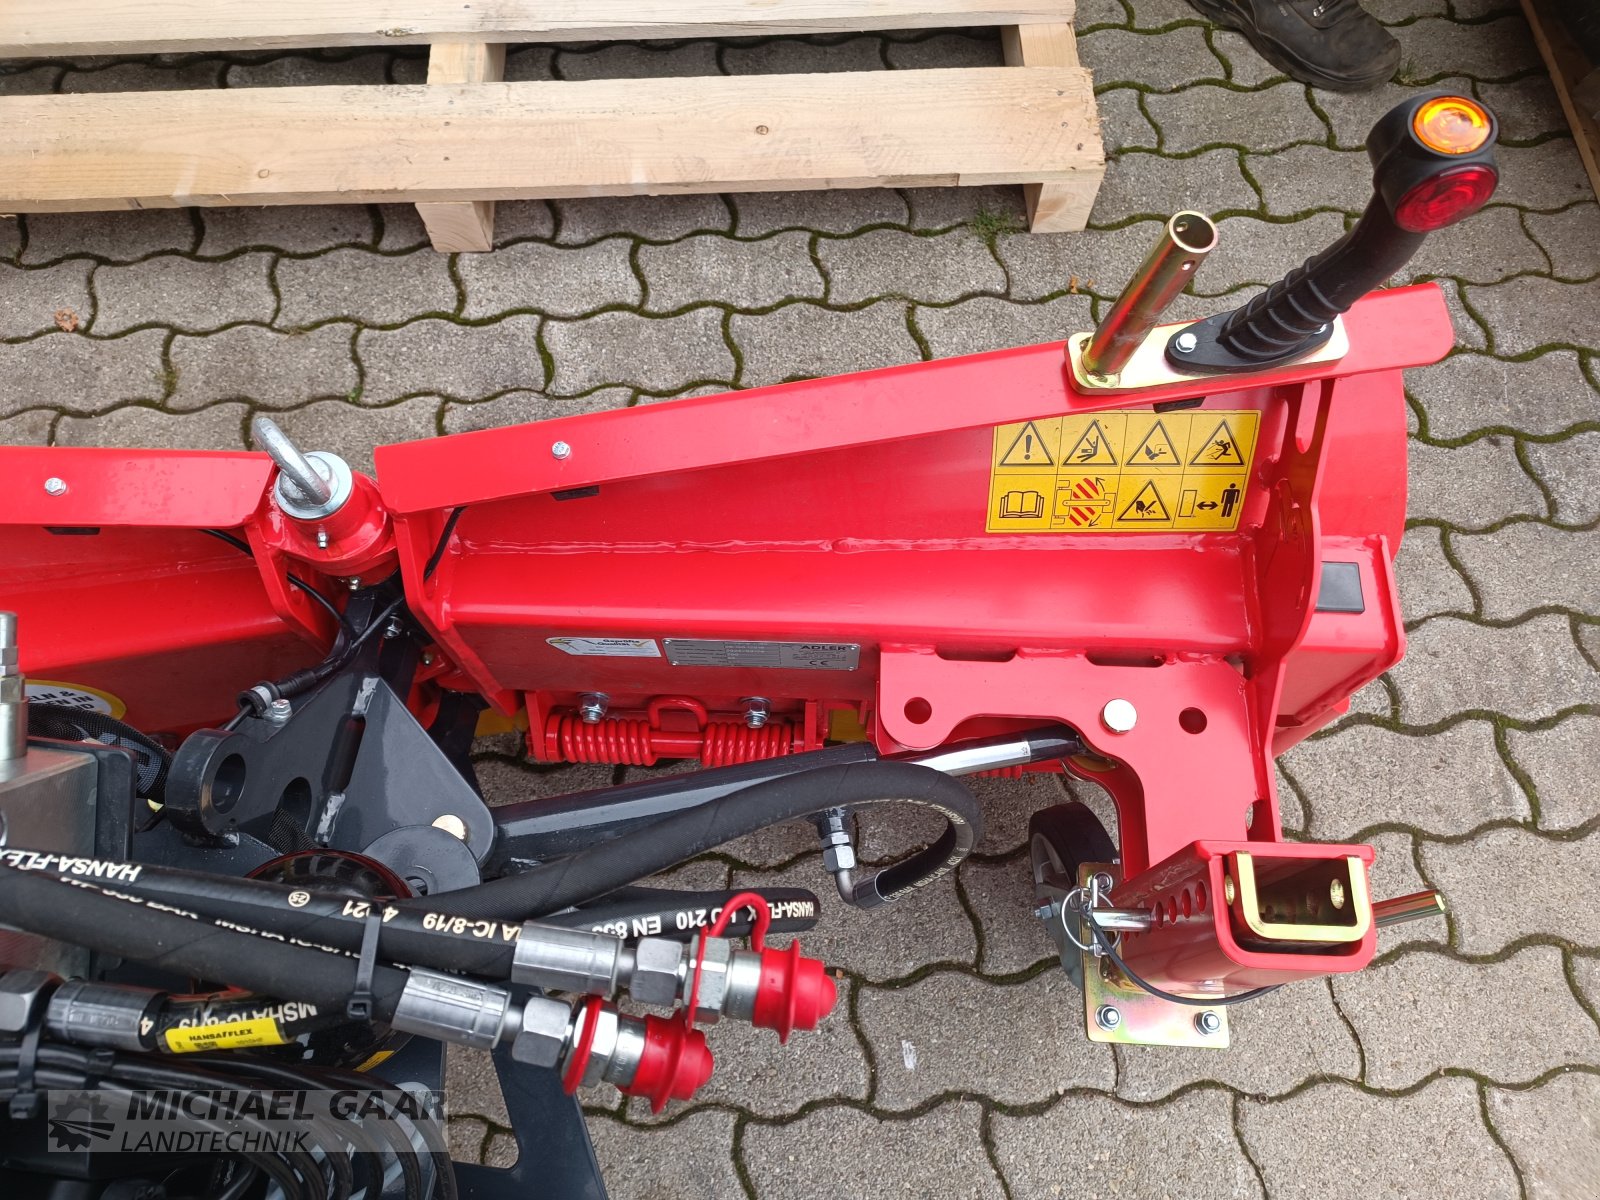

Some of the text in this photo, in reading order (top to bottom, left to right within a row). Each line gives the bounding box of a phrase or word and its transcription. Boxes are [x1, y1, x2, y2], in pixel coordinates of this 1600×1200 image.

[675, 909, 707, 931] 210
[746, 901, 814, 922] HANSA-FLX
[422, 912, 498, 940] IC-8/19
[632, 915, 661, 938] EN
